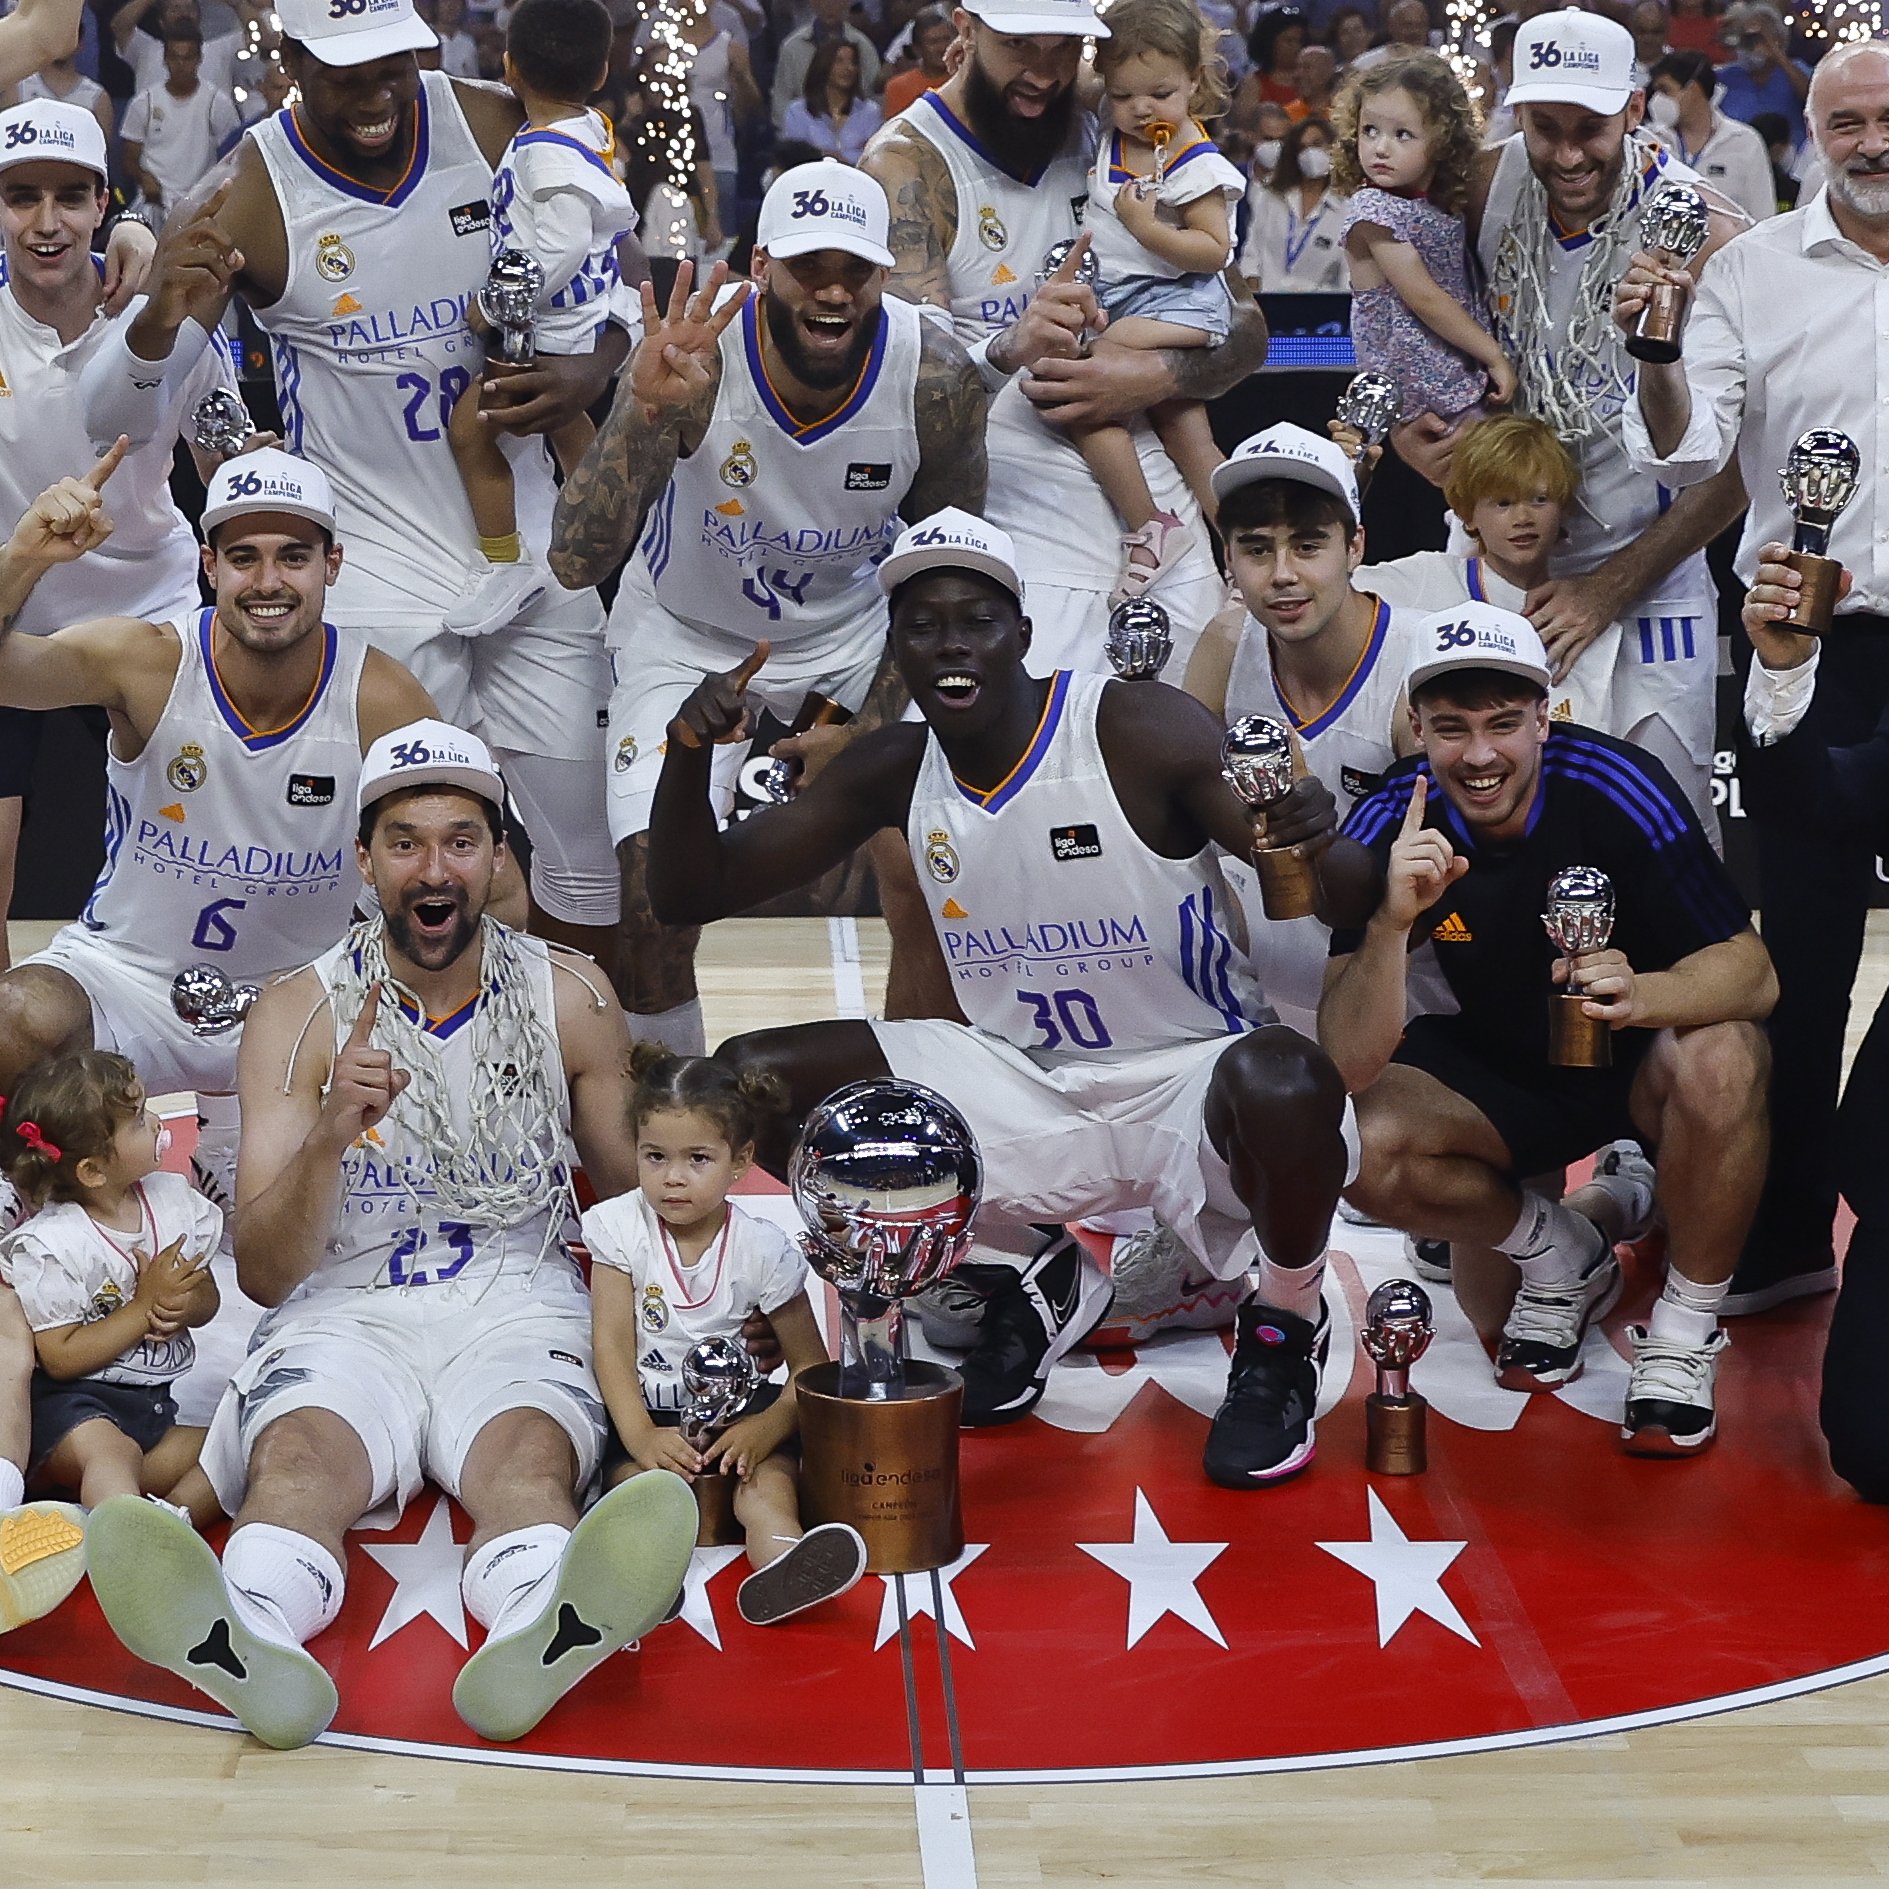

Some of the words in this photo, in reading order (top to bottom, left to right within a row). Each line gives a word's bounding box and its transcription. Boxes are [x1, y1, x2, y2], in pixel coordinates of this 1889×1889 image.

[1530, 40, 1562, 71] 36
[1563, 51, 1577, 62] LA
[1579, 52, 1600, 64] LIGA
[5, 120, 39, 149] 36
[39, 128, 54, 140] LA
[55, 129, 75, 144] LIGA
[791, 189, 830, 219] 36
[831, 201, 845, 214] LA
[846, 203, 868, 220] LIGA
[329, 289, 474, 347] PALLADI
[338, 345, 423, 365] HOTEL
[226, 470, 262, 502] 36
[263, 479, 279, 490] LA
[280, 480, 303, 494] LIGA
[702, 506, 887, 554] PALLADIUM
[948, 534, 962, 544] LA
[964, 537, 989, 552] LIGA
[742, 567, 814, 622] 44
[1436, 620, 1476, 653] 36
[1478, 631, 1493, 642] LA
[1494, 633, 1517, 649] LIGA
[390, 739, 431, 770] 36
[432, 747, 446, 760] LA
[447, 749, 471, 765] LIGA
[291, 794, 332, 803] endesa
[292, 783, 312, 796] liga
[137, 818, 343, 881] PALLADIUM
[1053, 837, 1076, 851] liga
[1057, 844, 1100, 858] endesa
[132, 852, 219, 889] HOTEL
[243, 878, 341, 898] GROUP
[190, 896, 247, 953] 6
[943, 914, 1150, 963] PALLADIUM
[1055, 953, 1155, 976] GROUP
[1015, 987, 1115, 1052] 30
[389, 1220, 476, 1286] 23
[840, 1468, 873, 1487] liga
[875, 1466, 941, 1486] endesa
